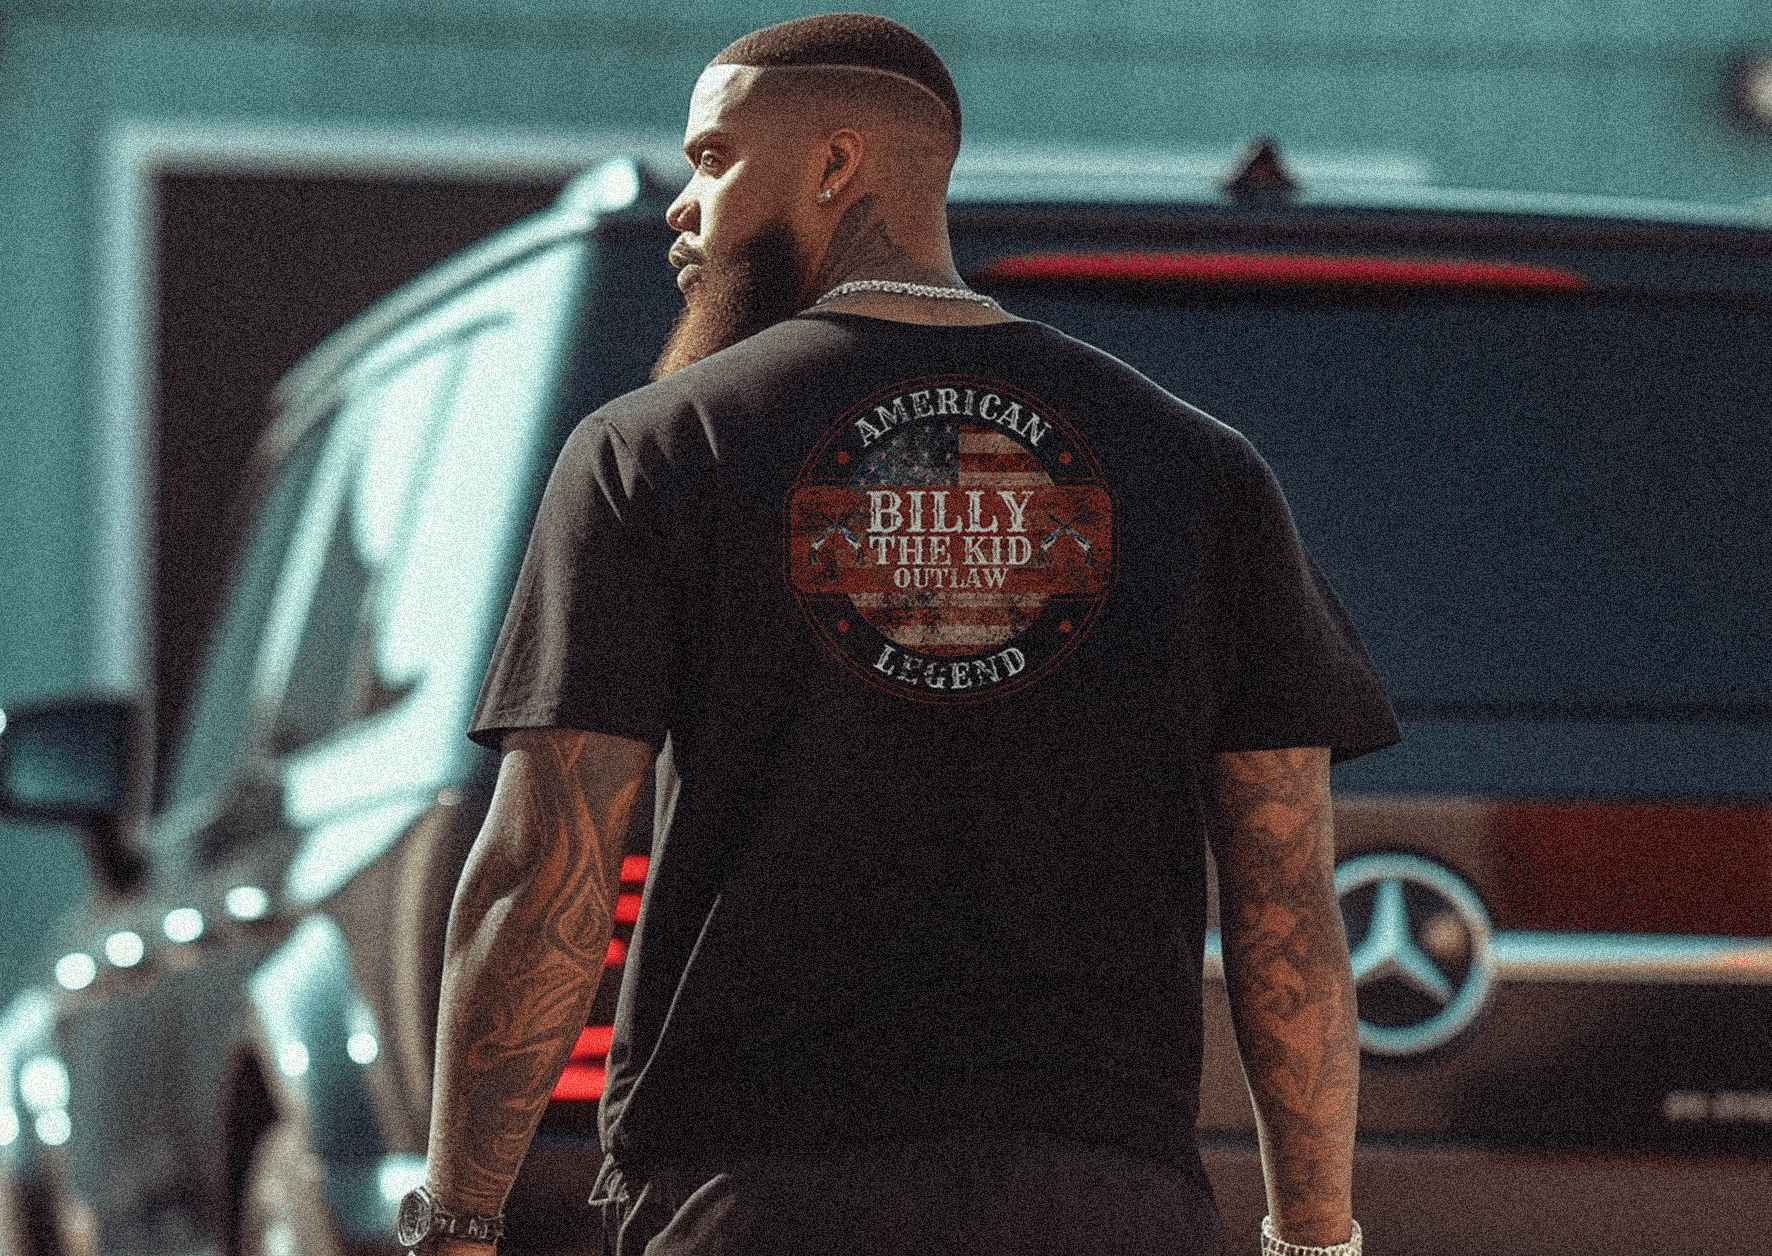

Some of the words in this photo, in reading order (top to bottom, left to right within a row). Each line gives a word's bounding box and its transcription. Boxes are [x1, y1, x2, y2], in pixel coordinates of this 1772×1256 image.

[854, 387, 1052, 448] AMERICAN
[865, 490, 1035, 533] BILLY
[868, 535, 951, 566] THE
[962, 535, 1032, 566] KID
[893, 567, 1009, 588] OUTLAW
[873, 644, 1026, 689] LEGEND
